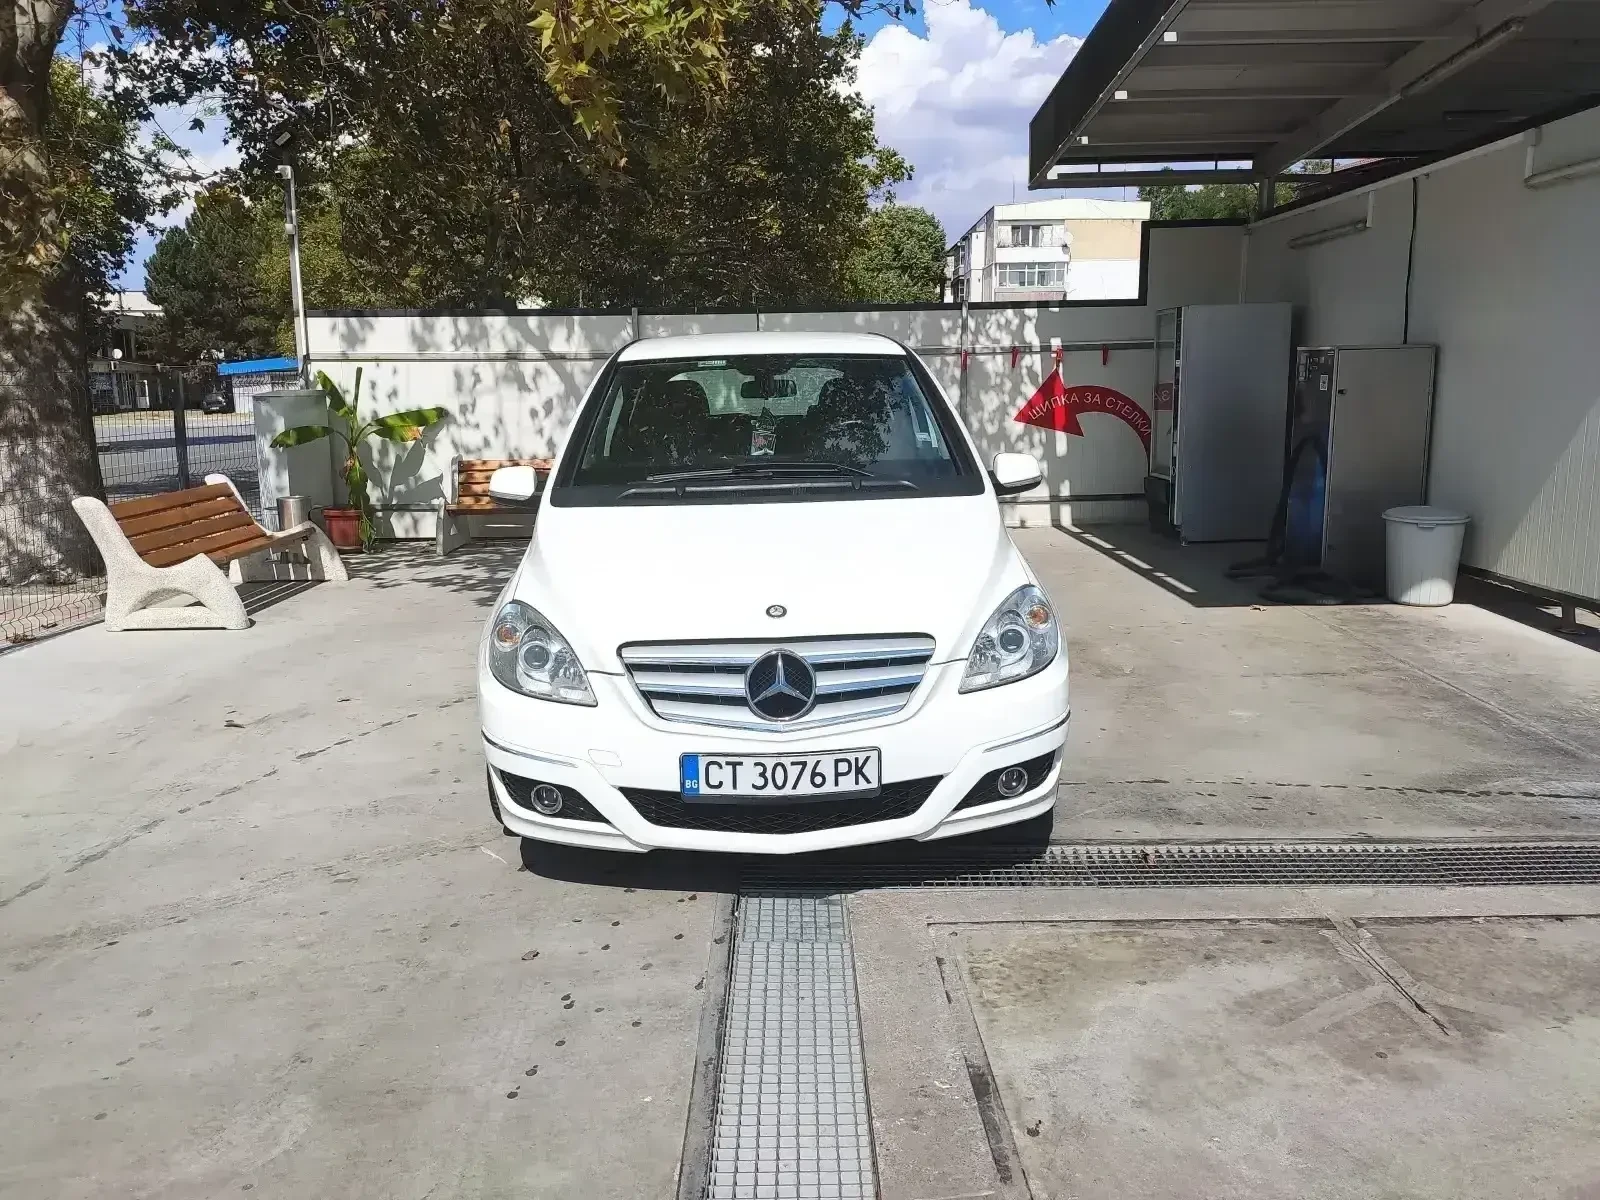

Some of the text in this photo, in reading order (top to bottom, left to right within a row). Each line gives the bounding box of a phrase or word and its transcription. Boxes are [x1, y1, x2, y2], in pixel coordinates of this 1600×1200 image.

[1028, 392, 1152, 436] ЩИПКА ЗА СТЕЛКИ
[685, 780, 698, 789] BG
[704, 755, 872, 790] CT 3076 PK
